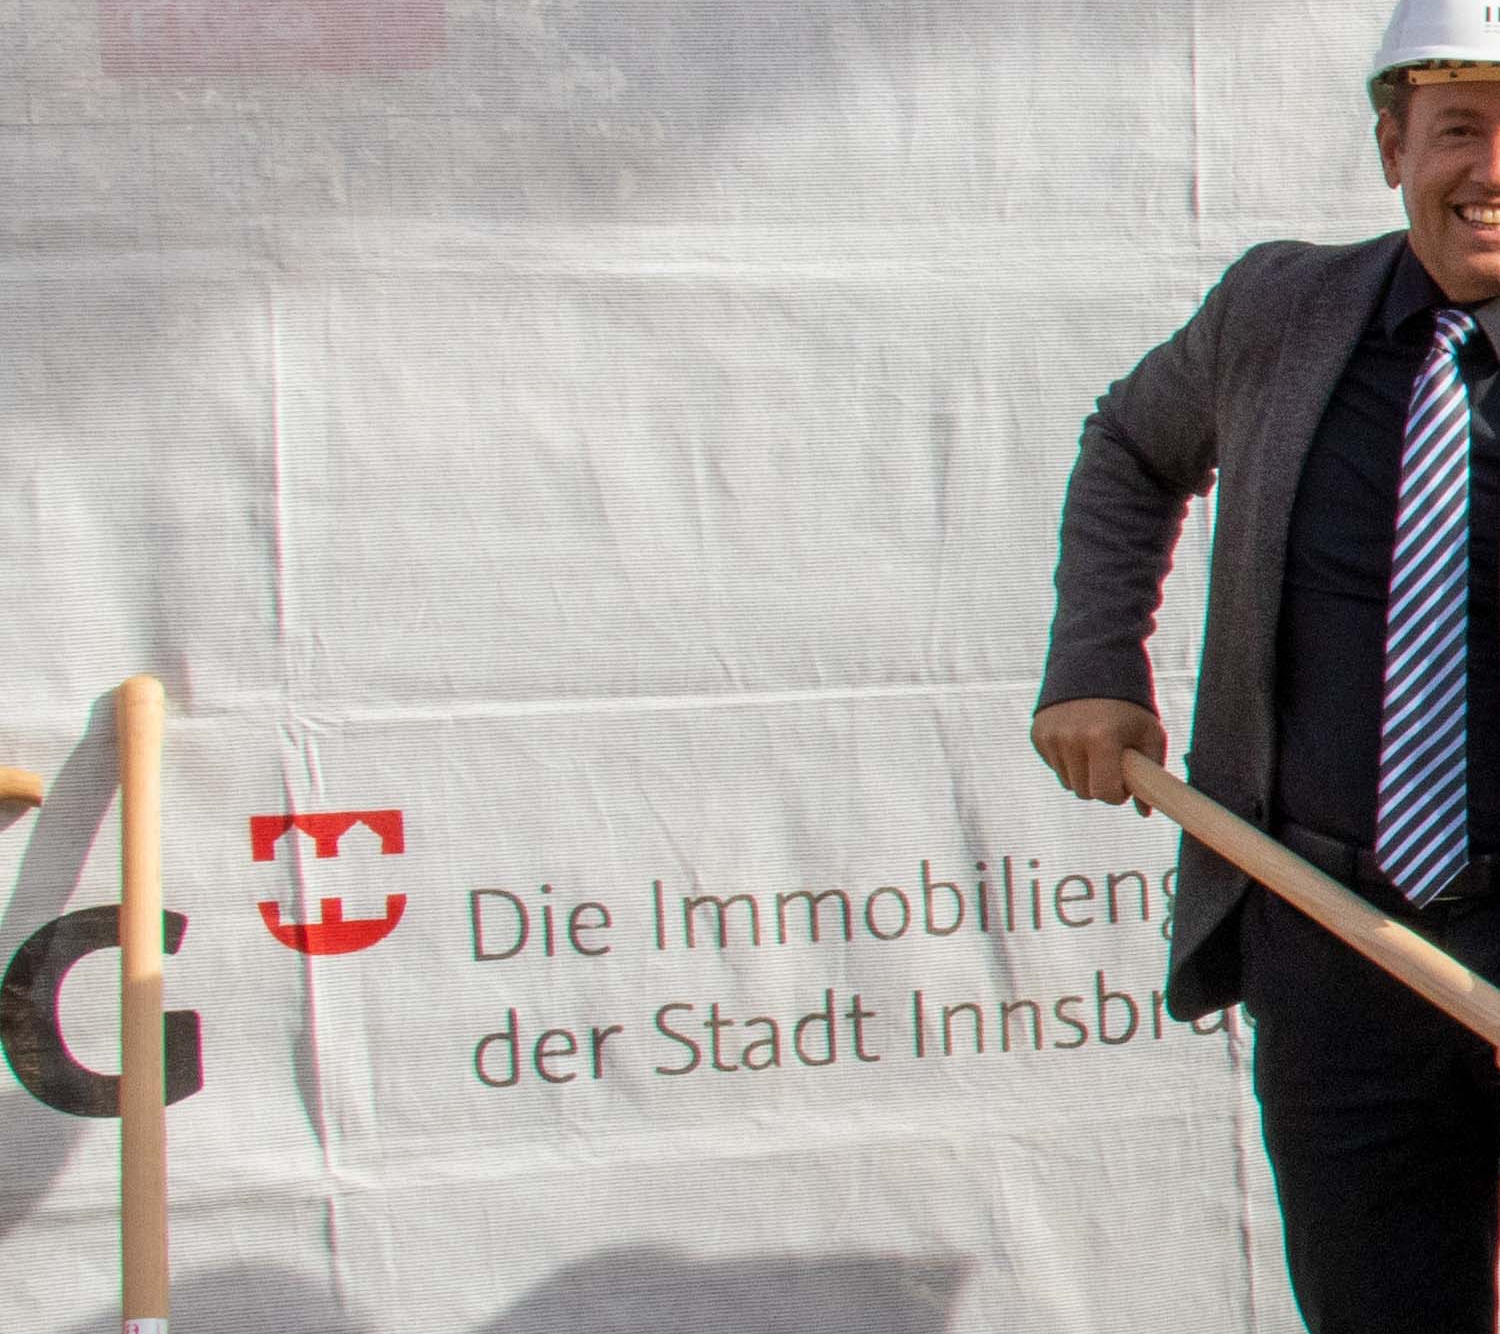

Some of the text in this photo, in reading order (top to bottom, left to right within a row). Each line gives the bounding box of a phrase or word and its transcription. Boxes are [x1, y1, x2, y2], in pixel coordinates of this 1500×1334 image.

[469, 883, 612, 962] Die
[474, 1007, 623, 1089] der
[656, 987, 881, 1077] Stadt
